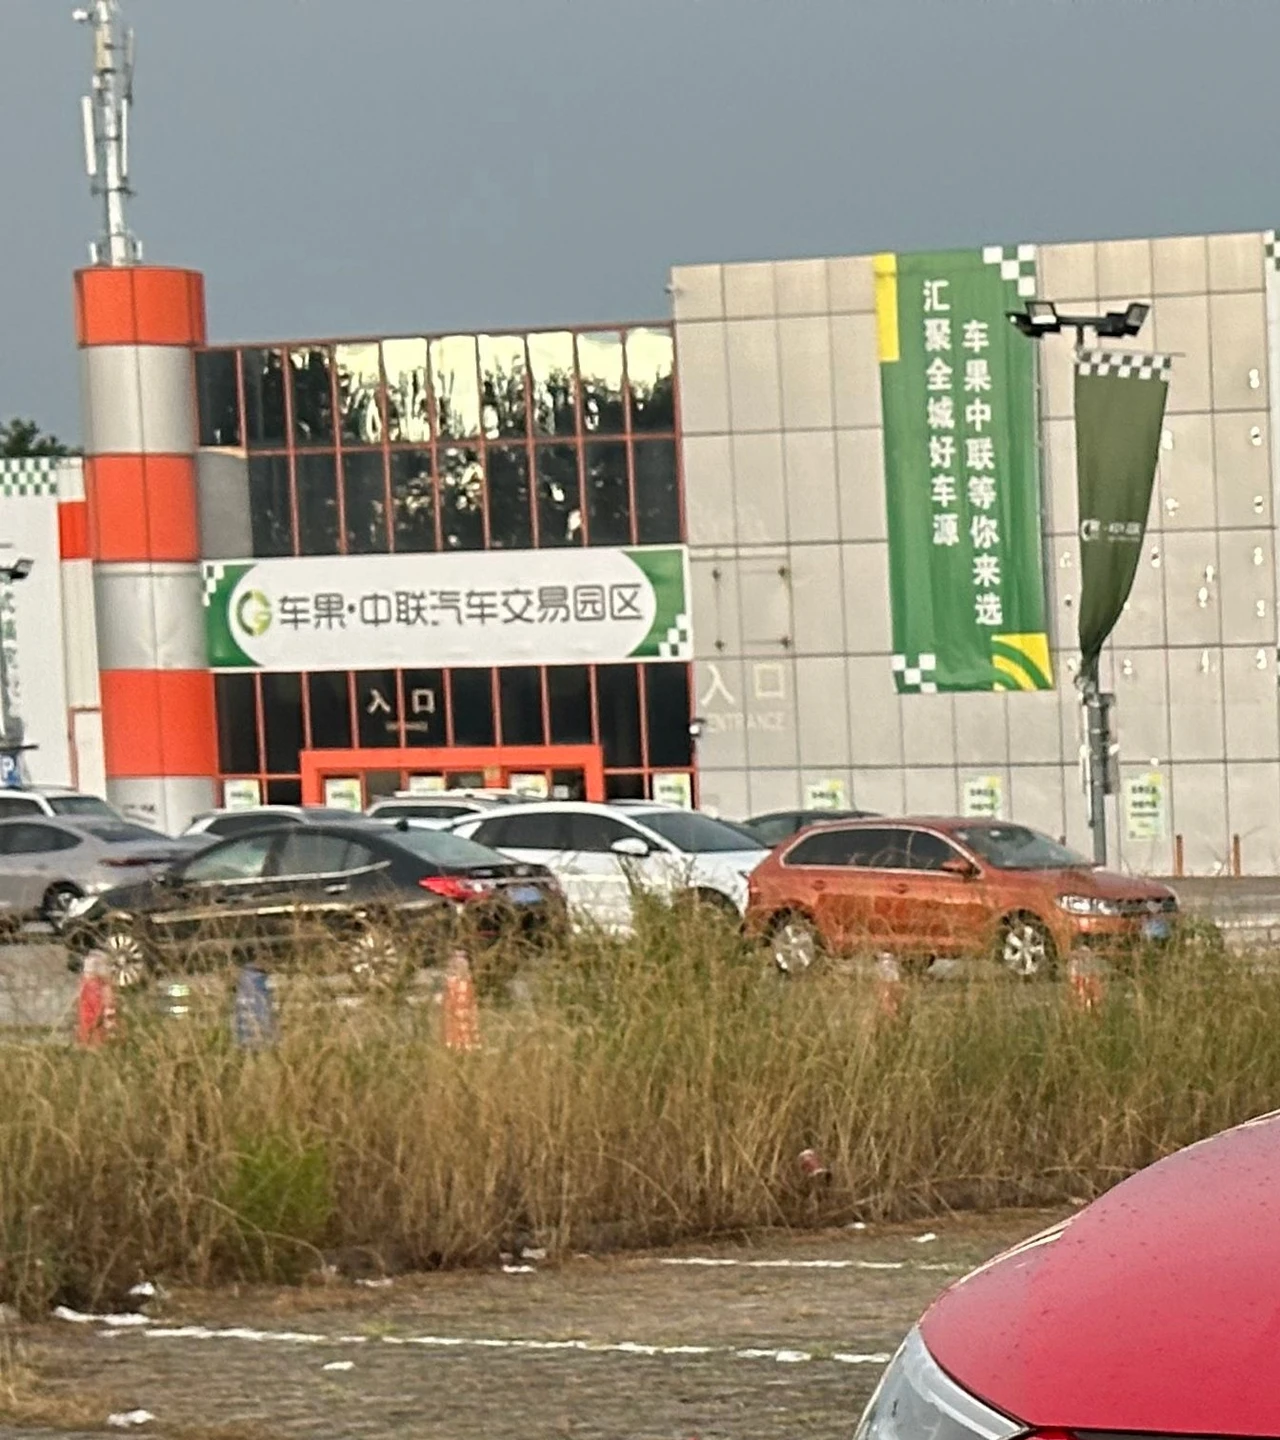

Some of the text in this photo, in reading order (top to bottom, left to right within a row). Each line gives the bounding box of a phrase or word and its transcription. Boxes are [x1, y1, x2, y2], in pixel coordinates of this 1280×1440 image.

[923, 279, 960, 547] 汇聚全城好车源
[962, 320, 1003, 626] 车果中联等你来选
[366, 688, 435, 714] 入口
[701, 663, 784, 706] 入口
